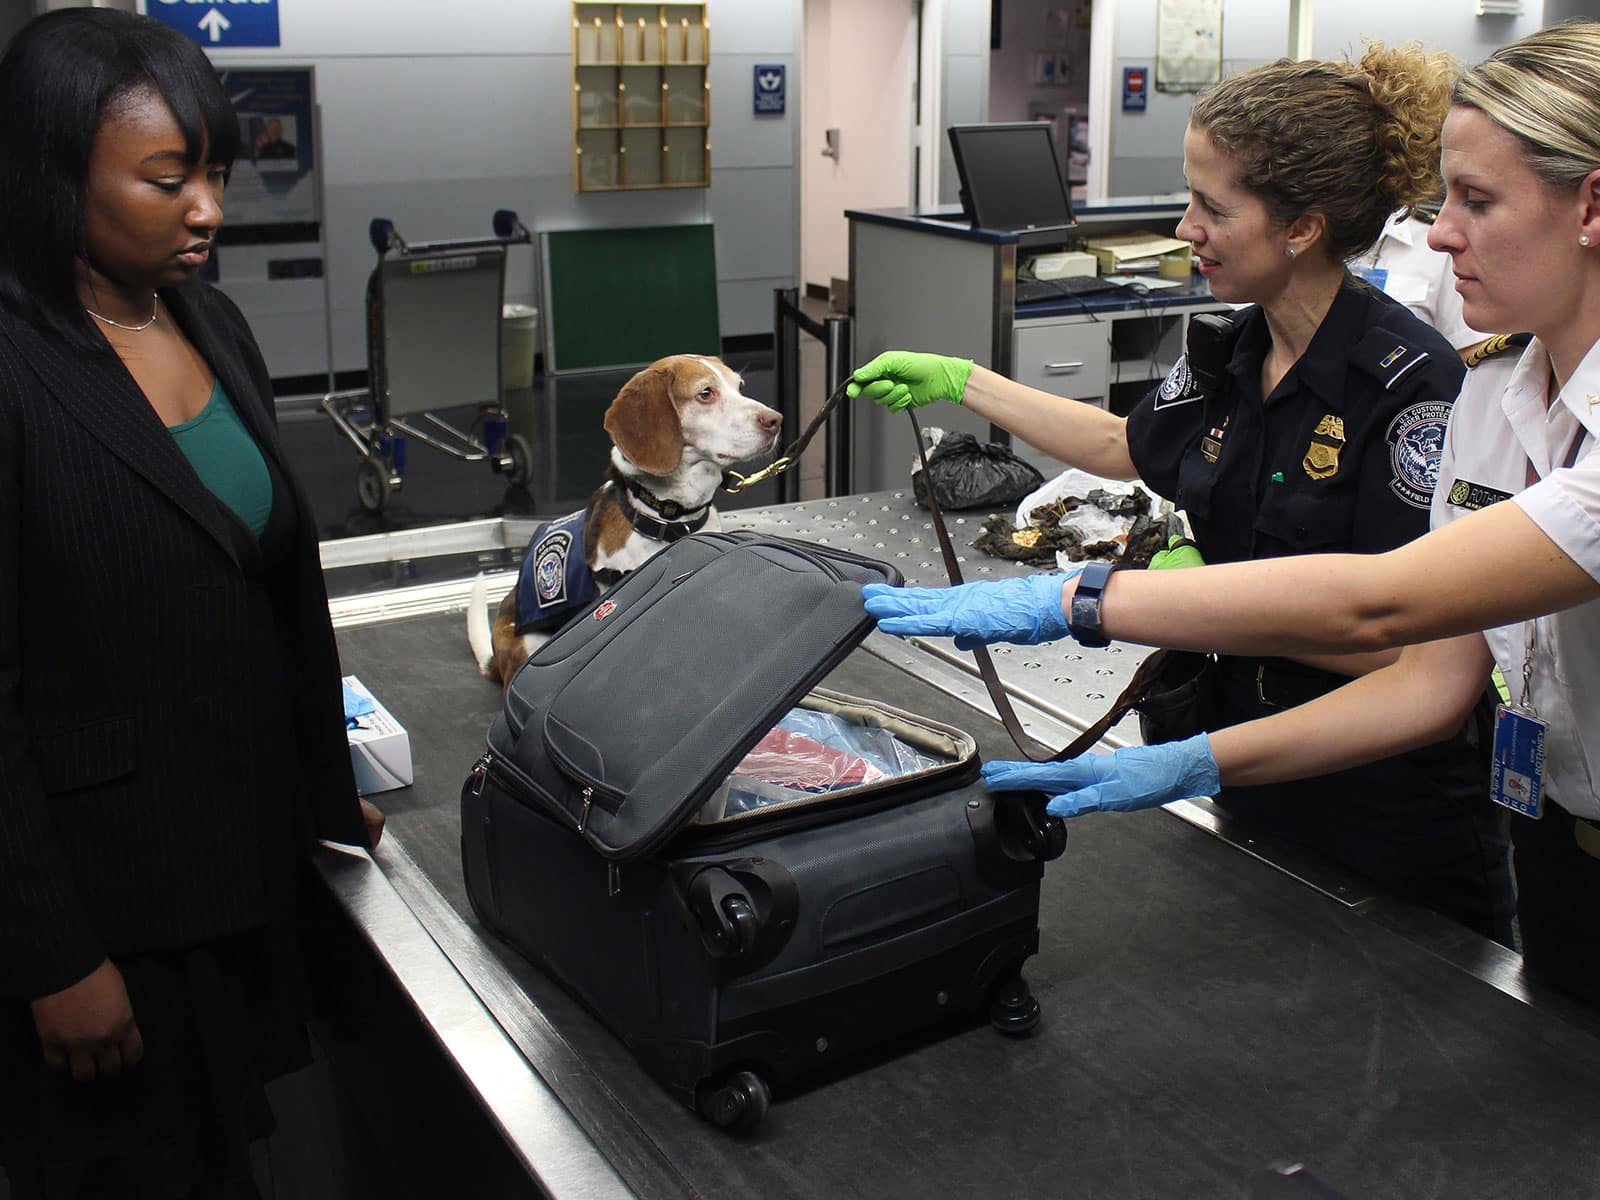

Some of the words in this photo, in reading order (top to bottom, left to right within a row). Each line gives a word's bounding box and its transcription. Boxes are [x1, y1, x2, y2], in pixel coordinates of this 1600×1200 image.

[1411, 405, 1445, 415] CUSTOMS
[1396, 416, 1421, 435] BORDER
[1421, 411, 1449, 419] PROTEC
[1410, 493, 1430, 503] FIELD
[1535, 729, 1544, 776] ROTHNEY
